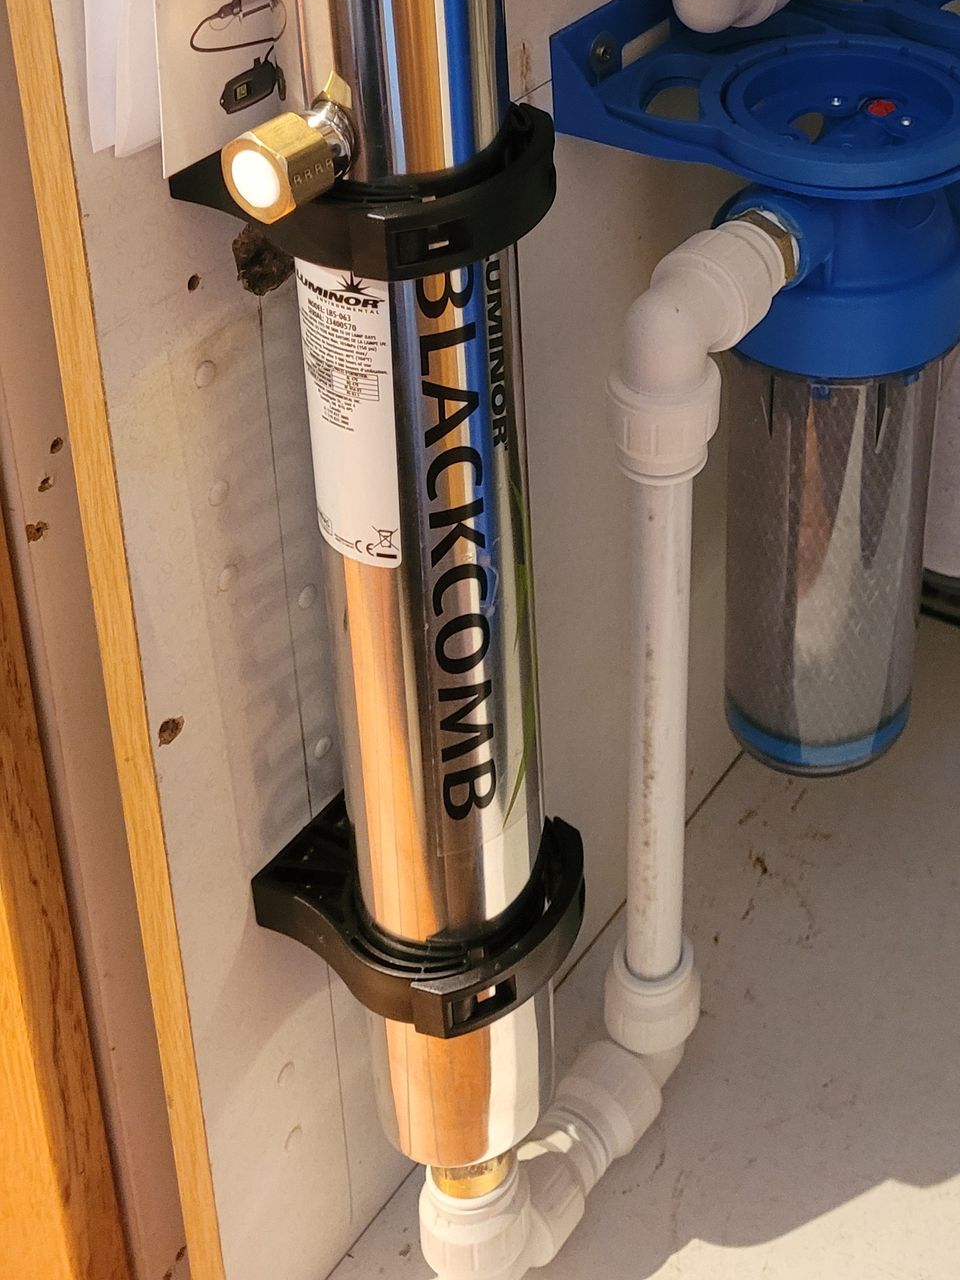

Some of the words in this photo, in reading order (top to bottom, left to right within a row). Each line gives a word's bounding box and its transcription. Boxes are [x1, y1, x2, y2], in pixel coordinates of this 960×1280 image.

[296, 268, 381, 310] LUMINOR
[316, 295, 380, 316] ENVIRONMENTAL
[485, 253, 509, 448] UMINOR
[415, 264, 498, 822] BLACKCOMB
